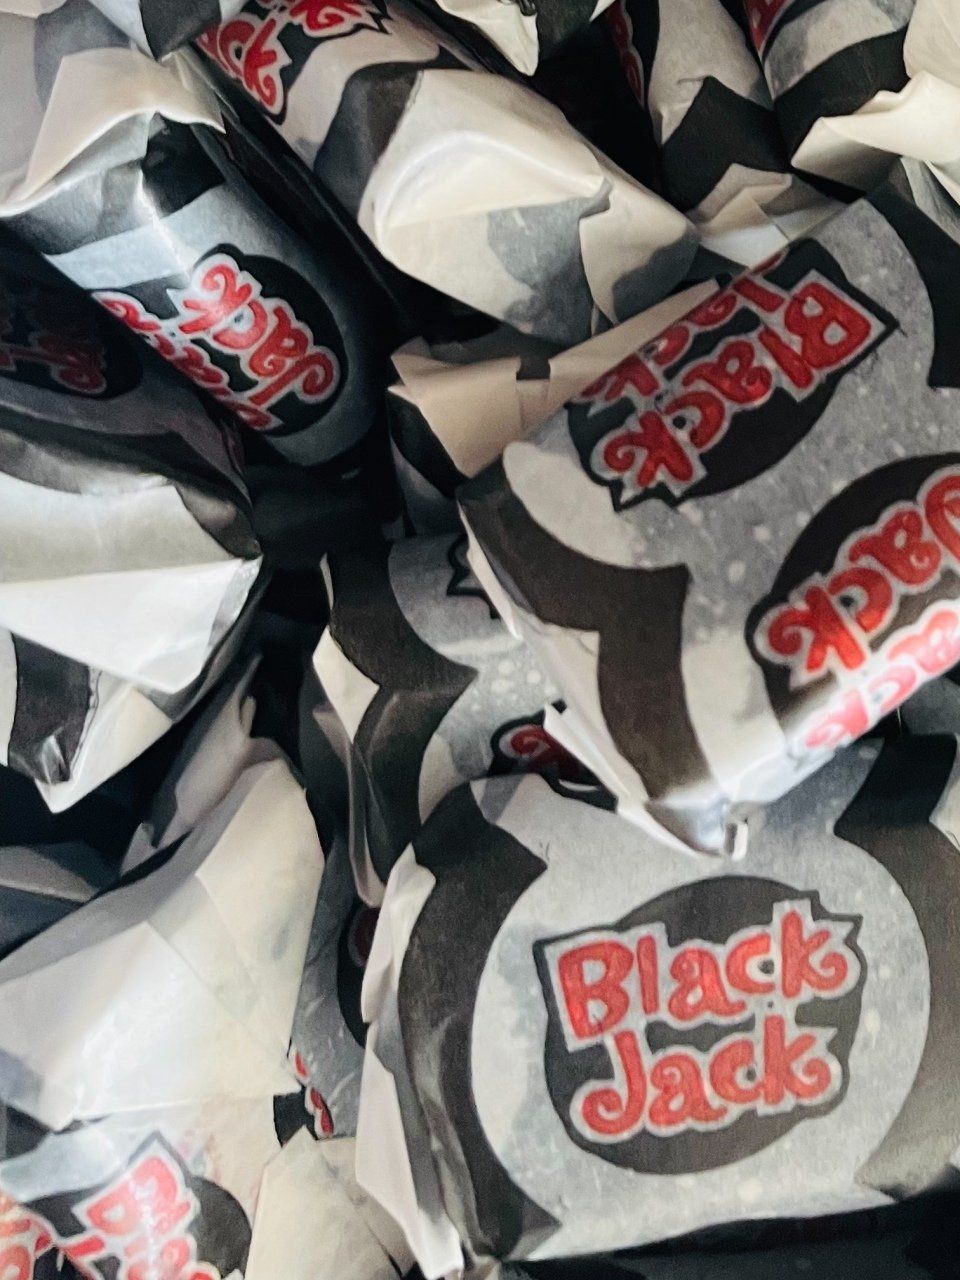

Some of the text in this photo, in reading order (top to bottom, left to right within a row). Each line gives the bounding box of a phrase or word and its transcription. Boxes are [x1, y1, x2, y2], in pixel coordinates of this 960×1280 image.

[177, 263, 335, 407] Jack
[602, 281, 873, 488] Black
[557, 909, 849, 1040] Black
[581, 1015, 831, 1136] Jack
